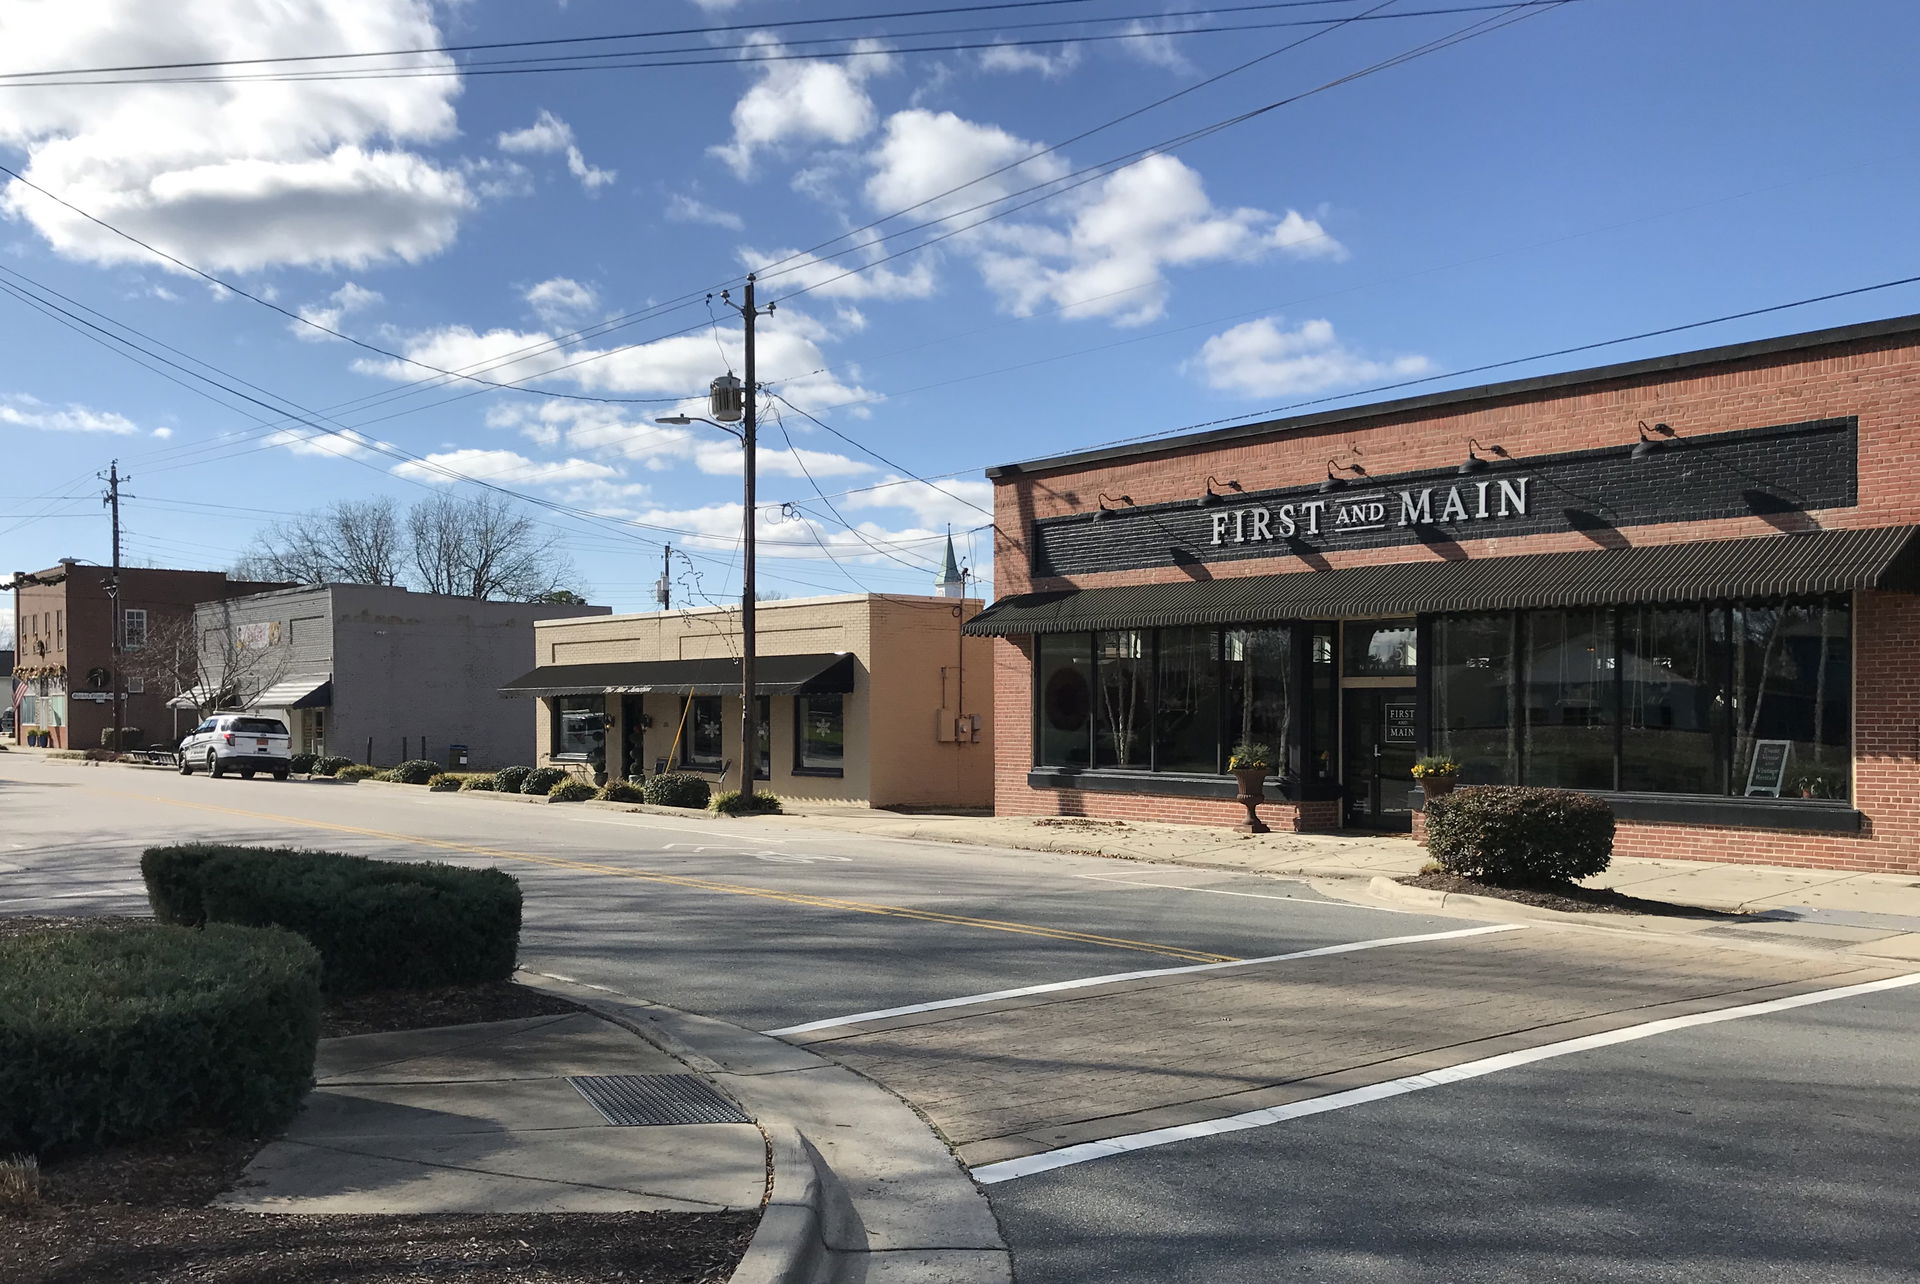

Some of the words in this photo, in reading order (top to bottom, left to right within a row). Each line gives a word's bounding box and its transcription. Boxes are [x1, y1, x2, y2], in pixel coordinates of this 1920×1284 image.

[1210, 501, 1326, 545] FIRST
[1335, 503, 1385, 524] AND
[1397, 477, 1530, 526] MAIN
[1390, 709, 1415, 718] FIRST
[1390, 728, 1415, 737] MAIN
